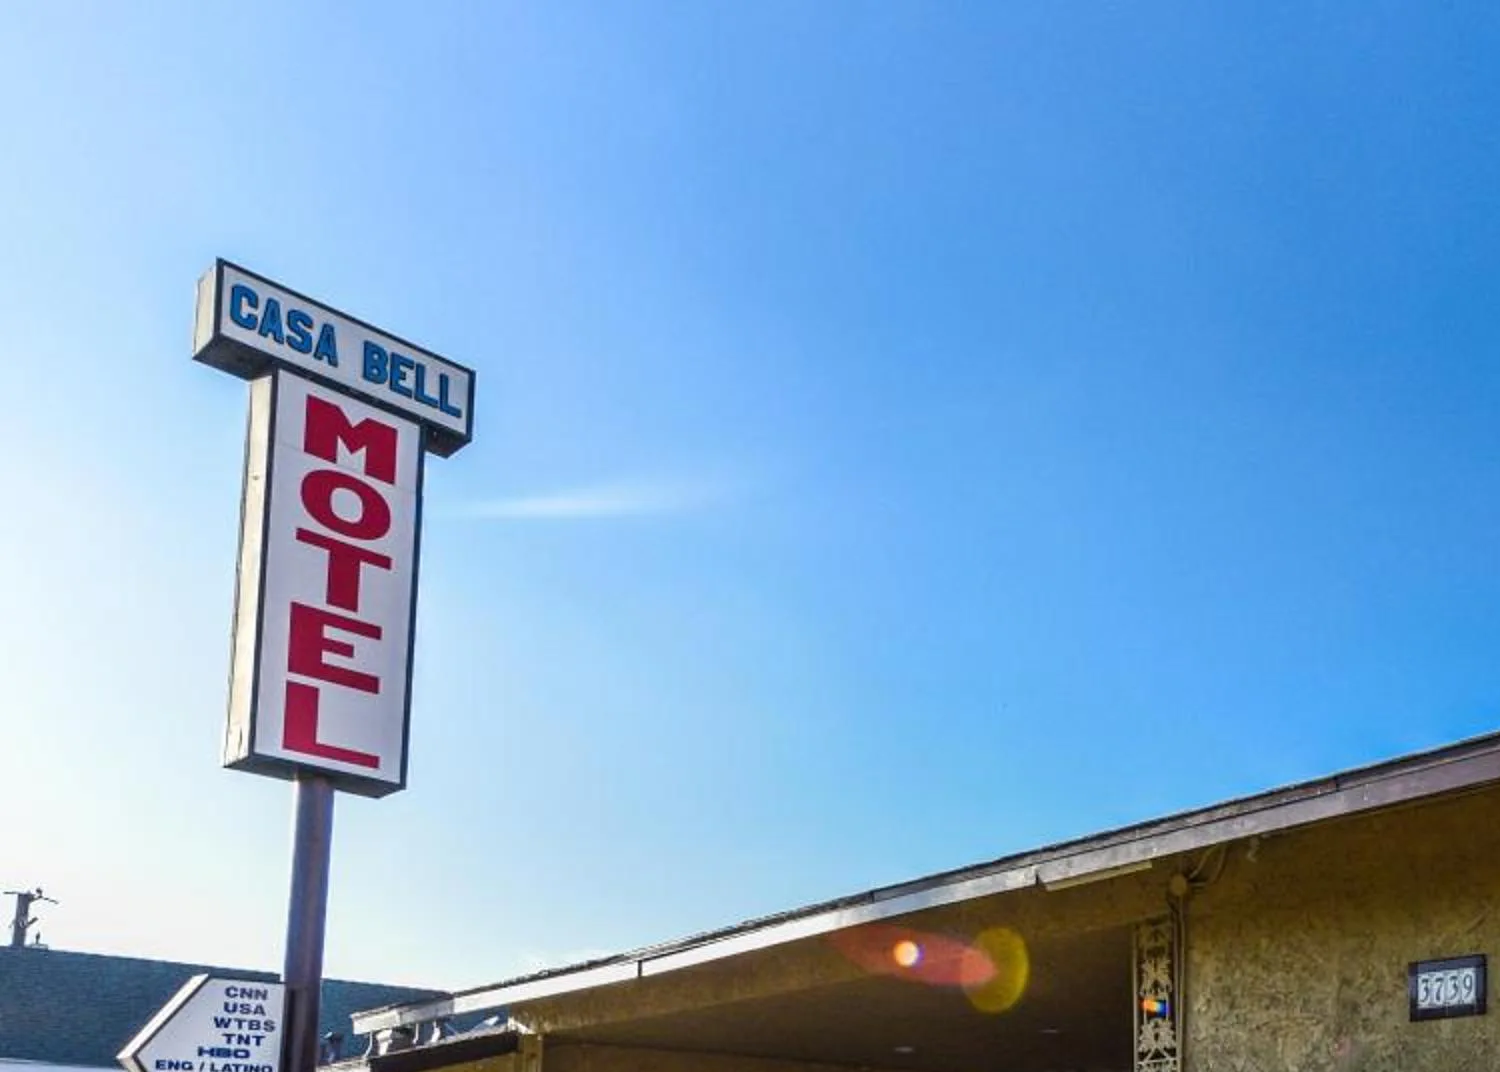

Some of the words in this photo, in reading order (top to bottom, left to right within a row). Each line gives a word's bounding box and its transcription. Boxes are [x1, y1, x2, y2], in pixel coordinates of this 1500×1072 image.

[230, 283, 338, 367] CASA
[362, 340, 462, 418] BELL
[282, 394, 399, 769] MOTEL
[225, 986, 268, 1000] CNN
[224, 1002, 266, 1015] USA
[214, 1017, 276, 1032] WTBS
[223, 1033, 265, 1046] TNT
[198, 1047, 250, 1058] HBO
